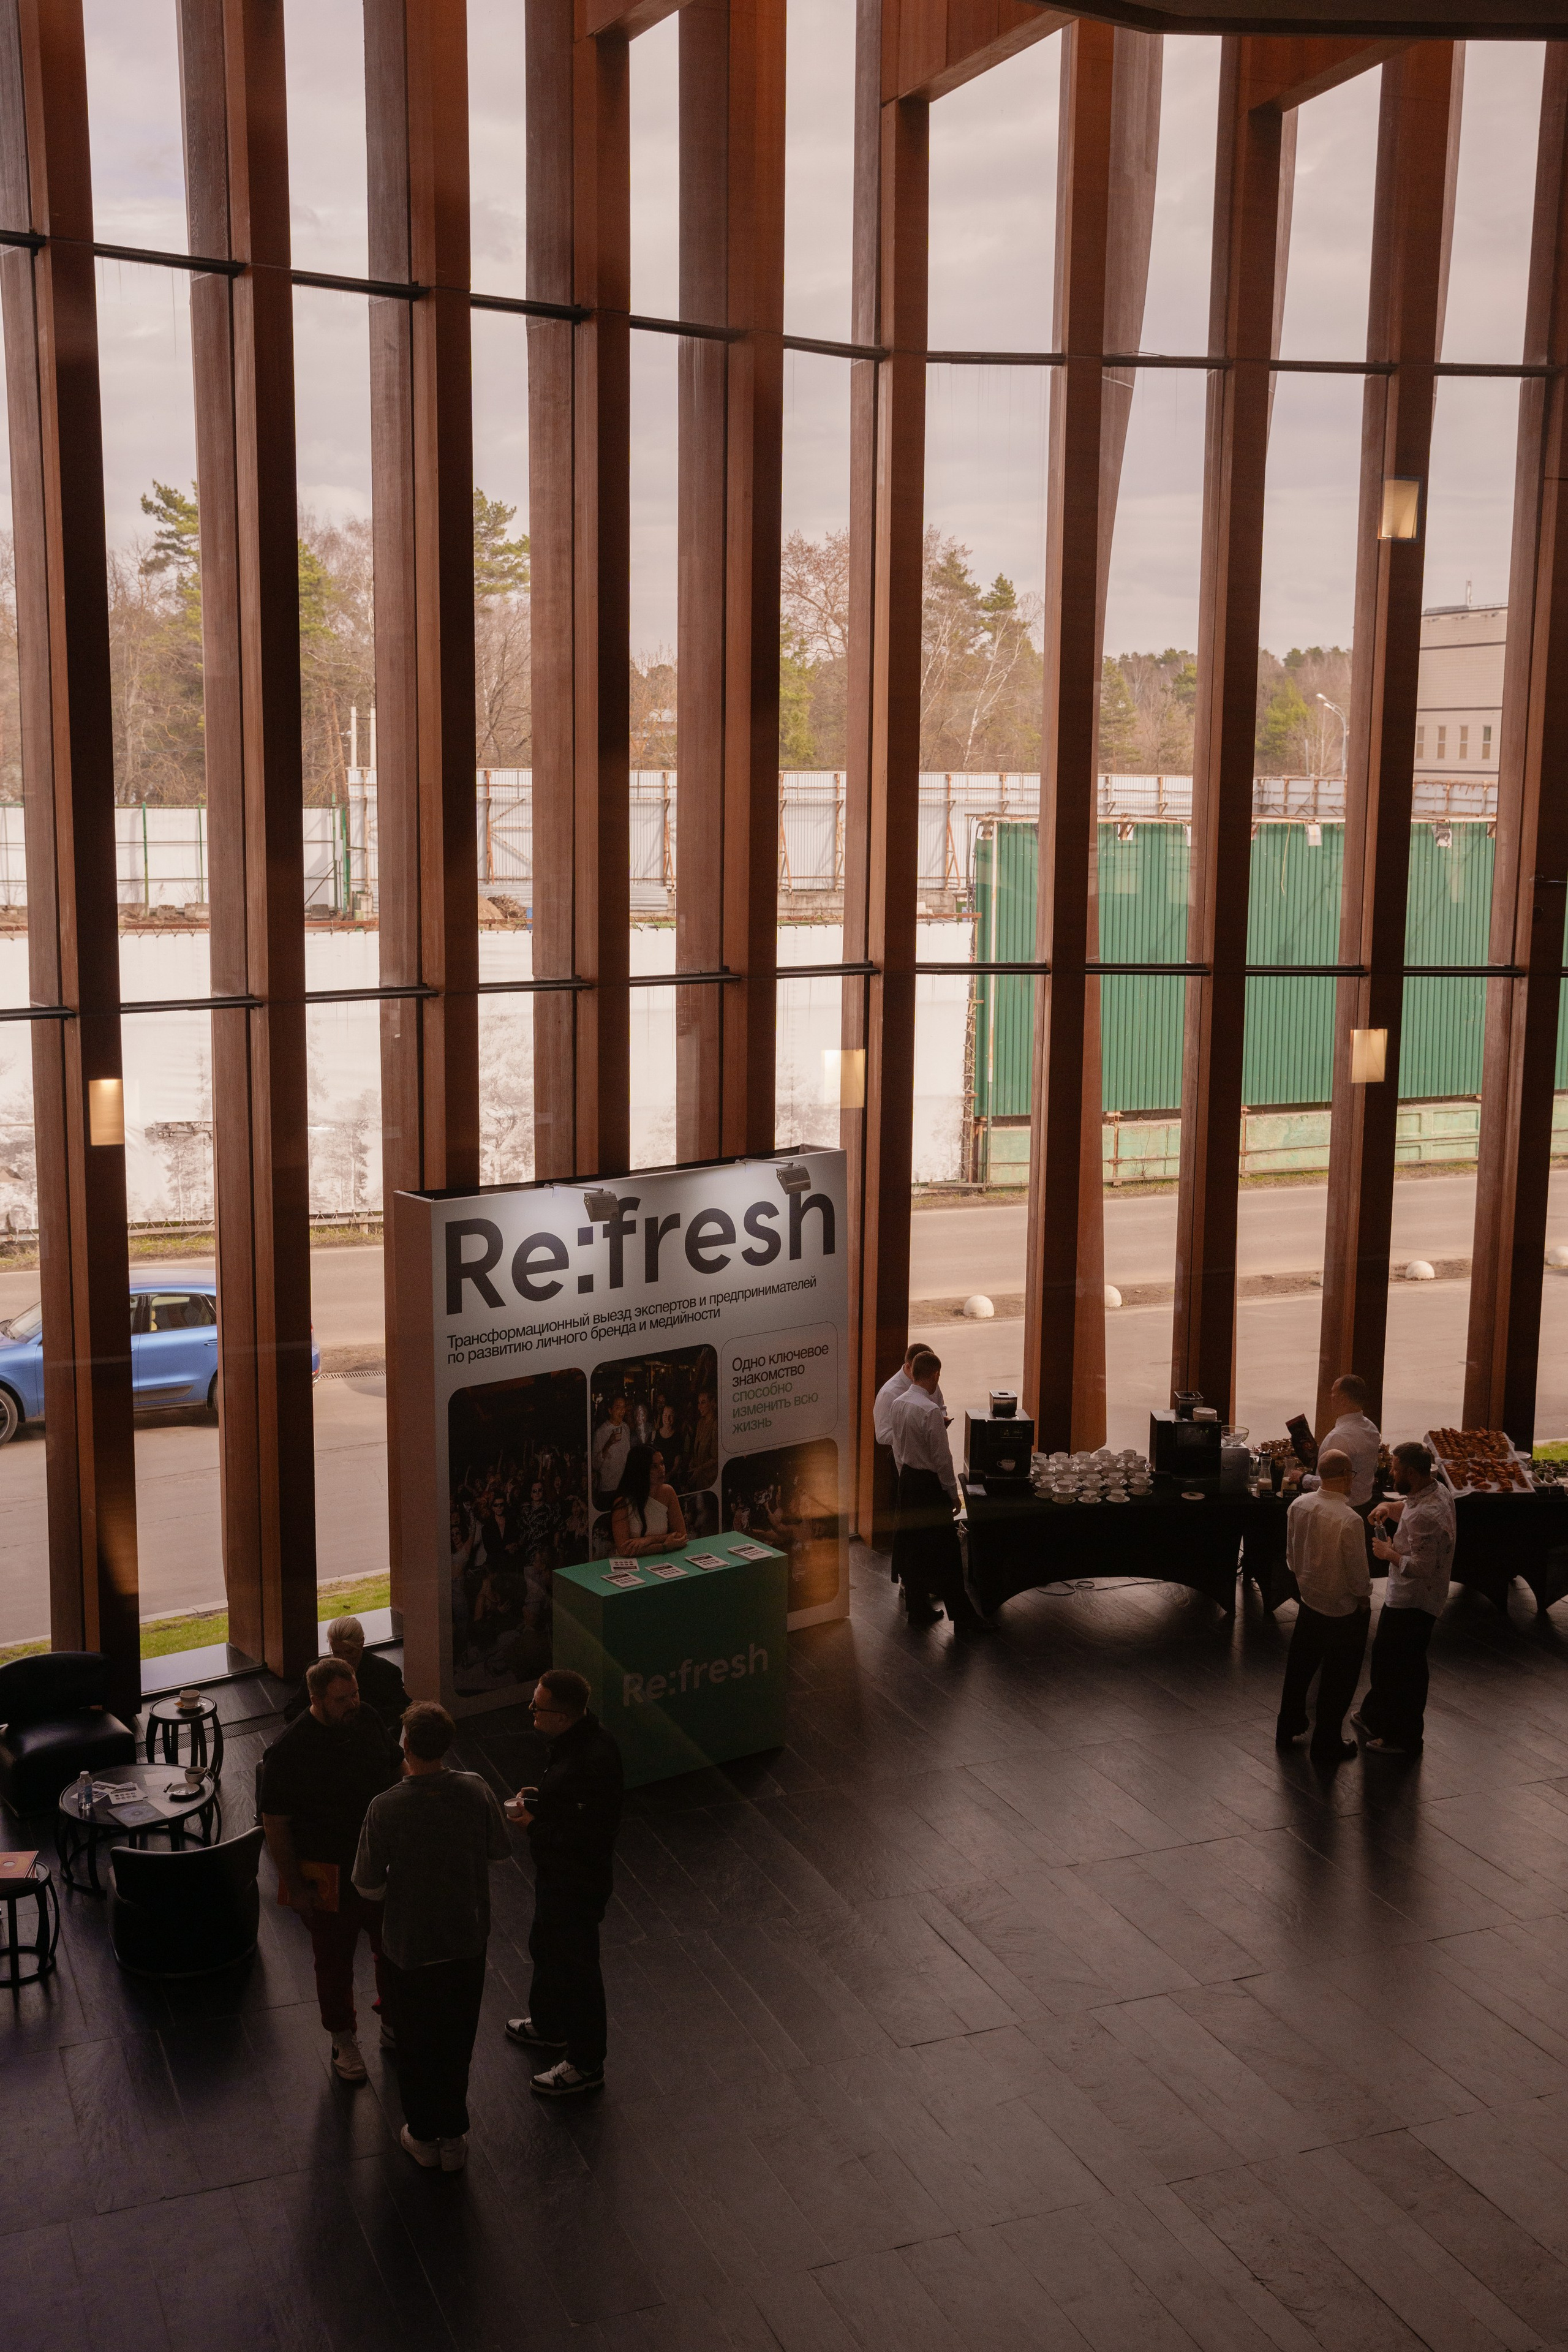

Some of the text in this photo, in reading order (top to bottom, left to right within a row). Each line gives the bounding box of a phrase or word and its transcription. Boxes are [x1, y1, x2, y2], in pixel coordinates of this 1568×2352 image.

[445, 1191, 835, 1315] Re:fresh
[447, 1275, 816, 1351] Трансформационный выезд экспертов и предпринимателей
[447, 1308, 720, 1364] по развитию личного бренда и медийности
[732, 1344, 829, 1373] Одно ключевое
[732, 1364, 805, 1387] знакомство
[732, 1381, 793, 1403] способно
[732, 1392, 819, 1419] изменить всю
[732, 1417, 772, 1434] жизнь
[622, 1643, 768, 1708] Re:fresh
